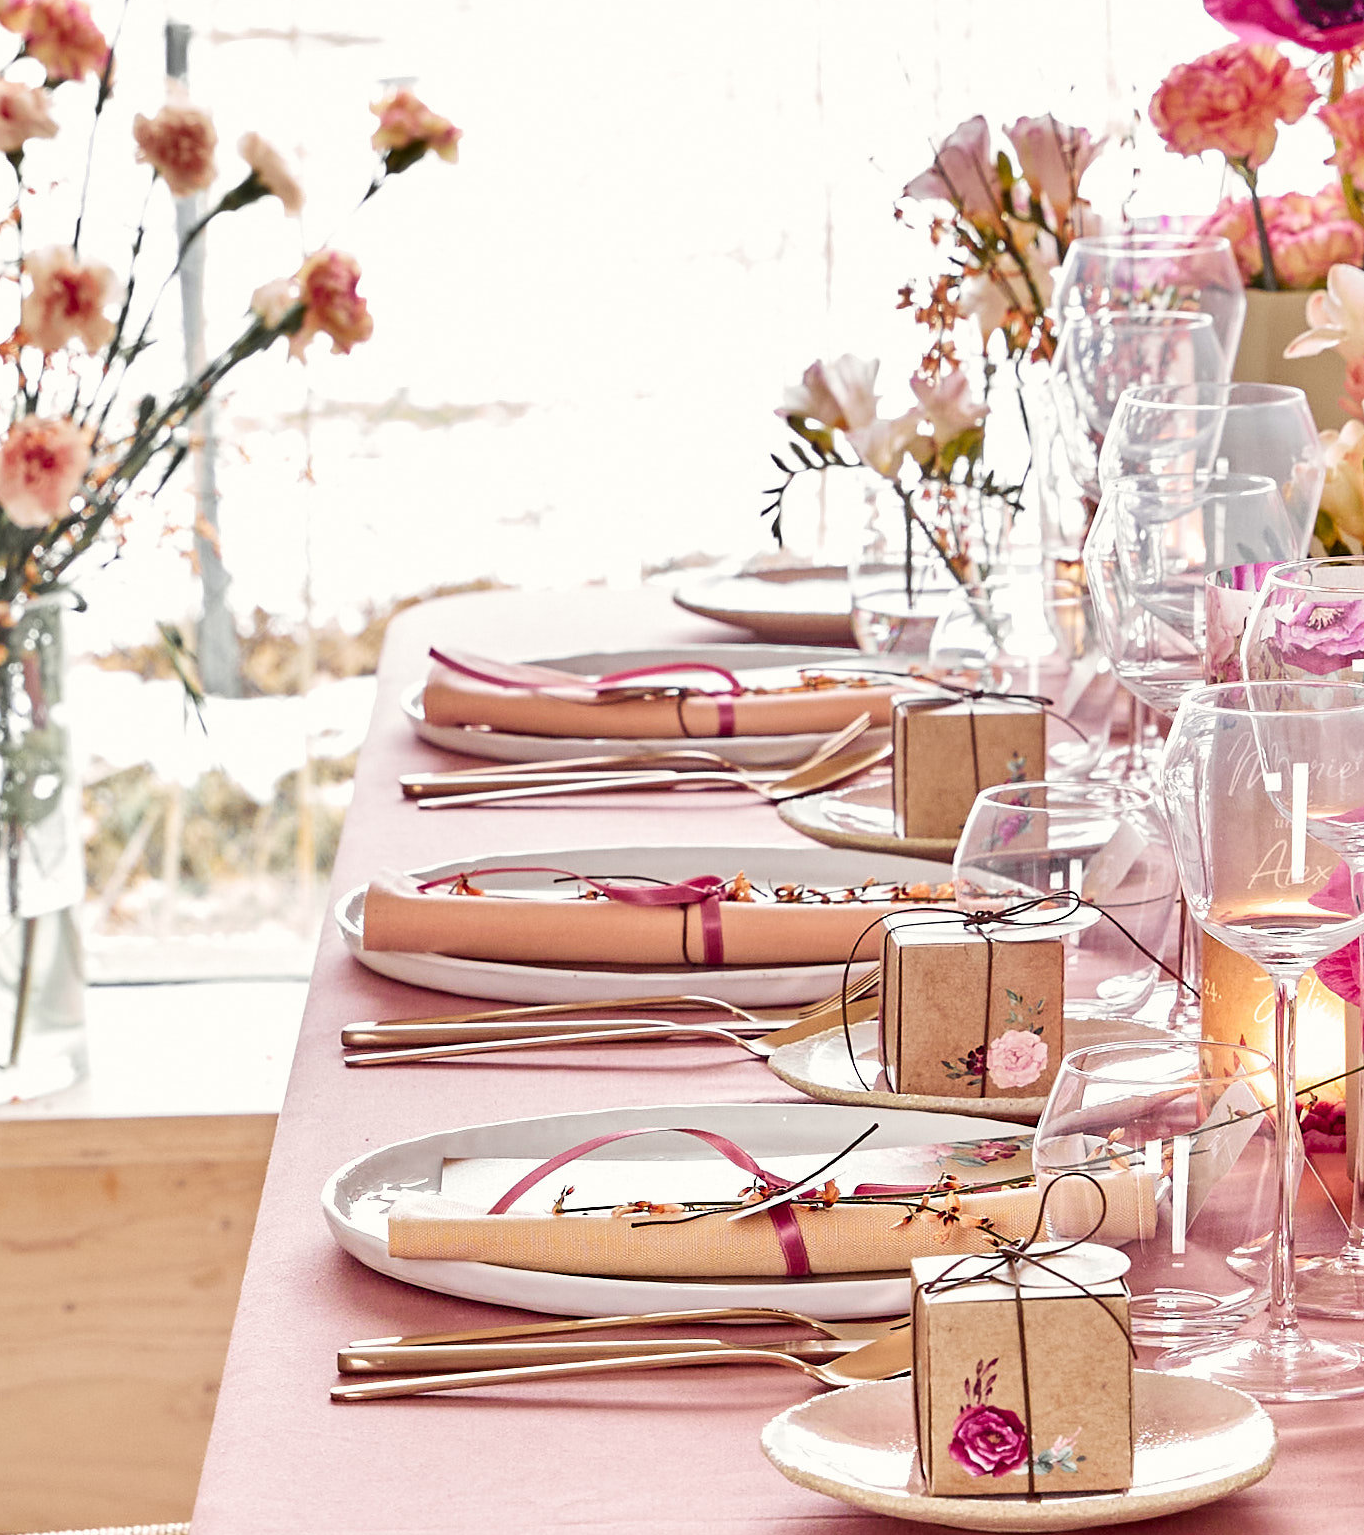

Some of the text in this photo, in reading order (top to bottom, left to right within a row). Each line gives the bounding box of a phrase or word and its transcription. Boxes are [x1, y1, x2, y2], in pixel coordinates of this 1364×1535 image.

[1227, 731, 1361, 797] Mrie
[1204, 975, 1329, 1024] 24. Jli
